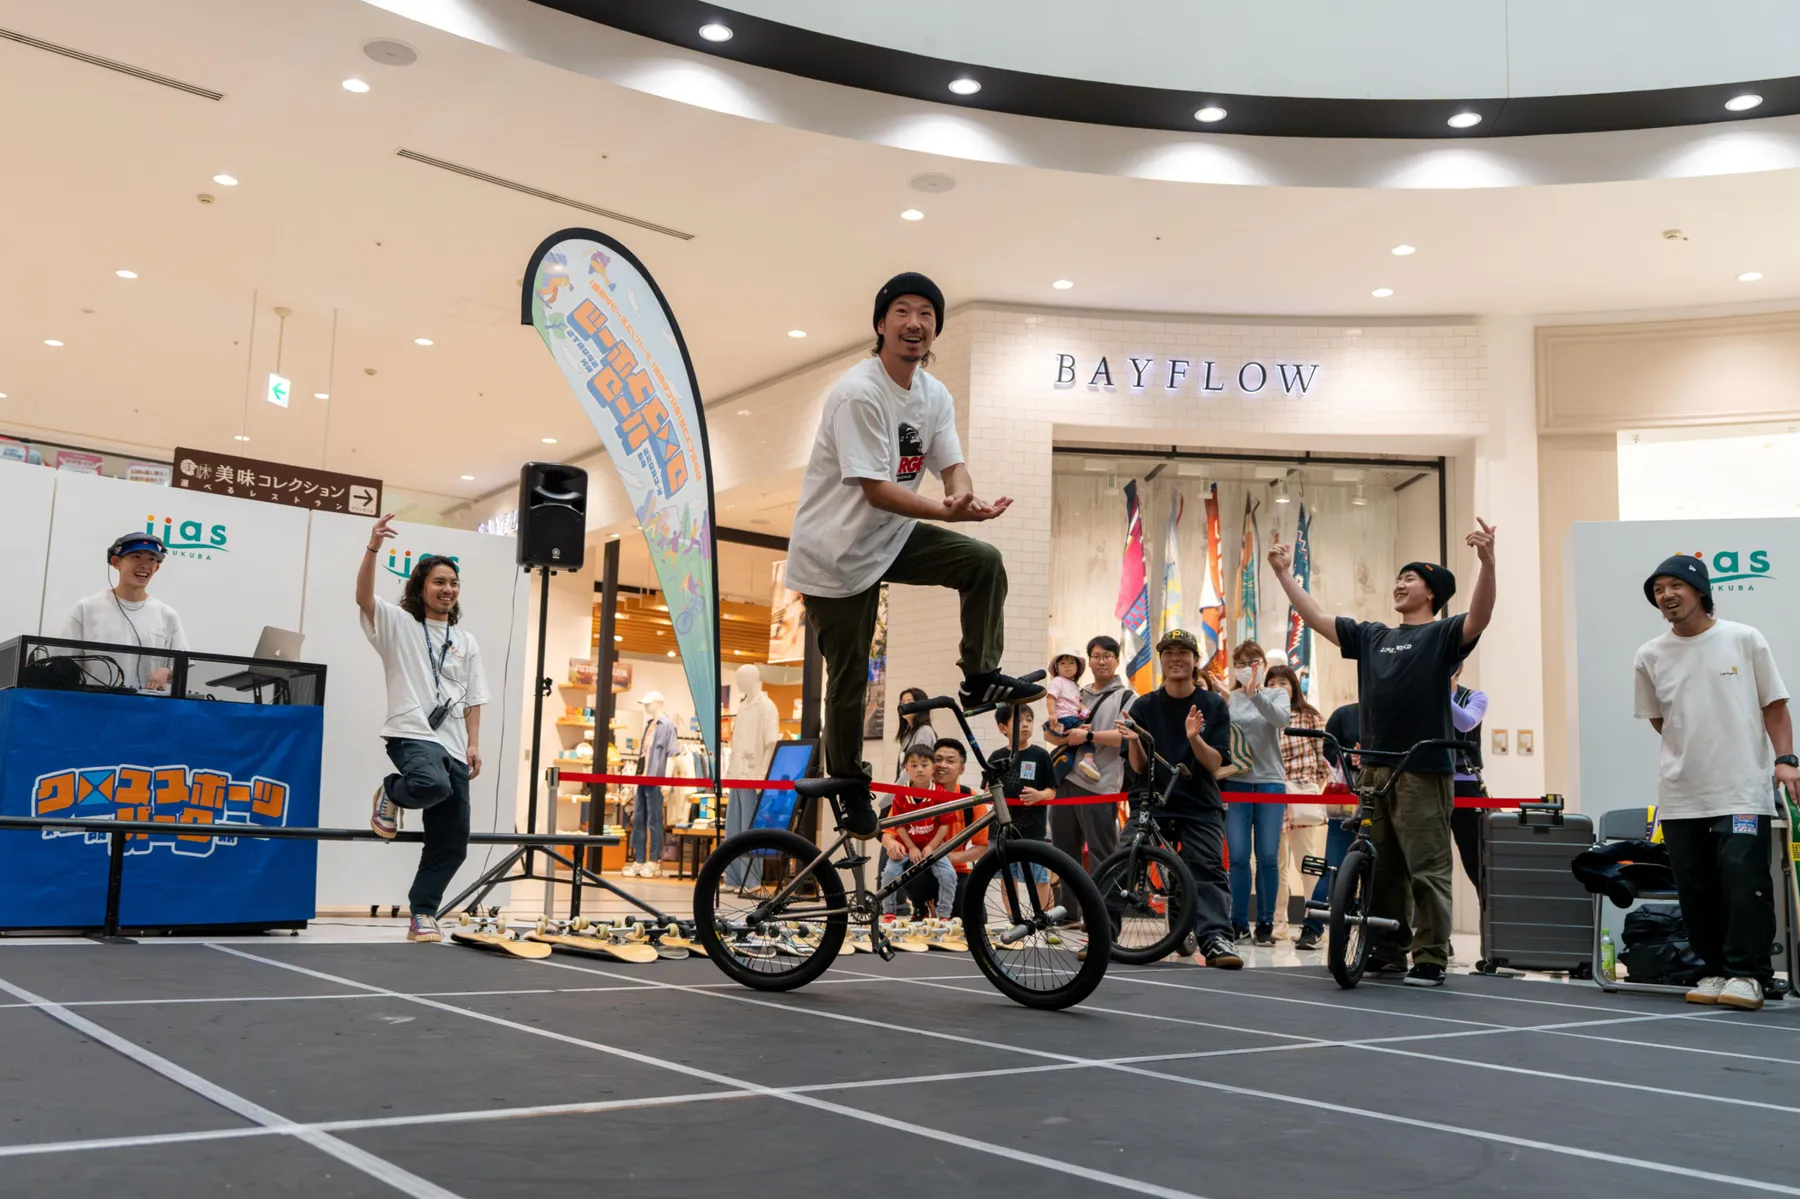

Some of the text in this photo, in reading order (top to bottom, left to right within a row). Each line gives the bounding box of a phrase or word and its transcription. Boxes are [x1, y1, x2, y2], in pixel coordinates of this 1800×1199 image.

[1056, 354, 1320, 393] BAYFLOW
[180, 479, 343, 510] 選べるレストラン
[215, 464, 345, 498] 美味コレクション
[1172, 630, 1181, 639] P
